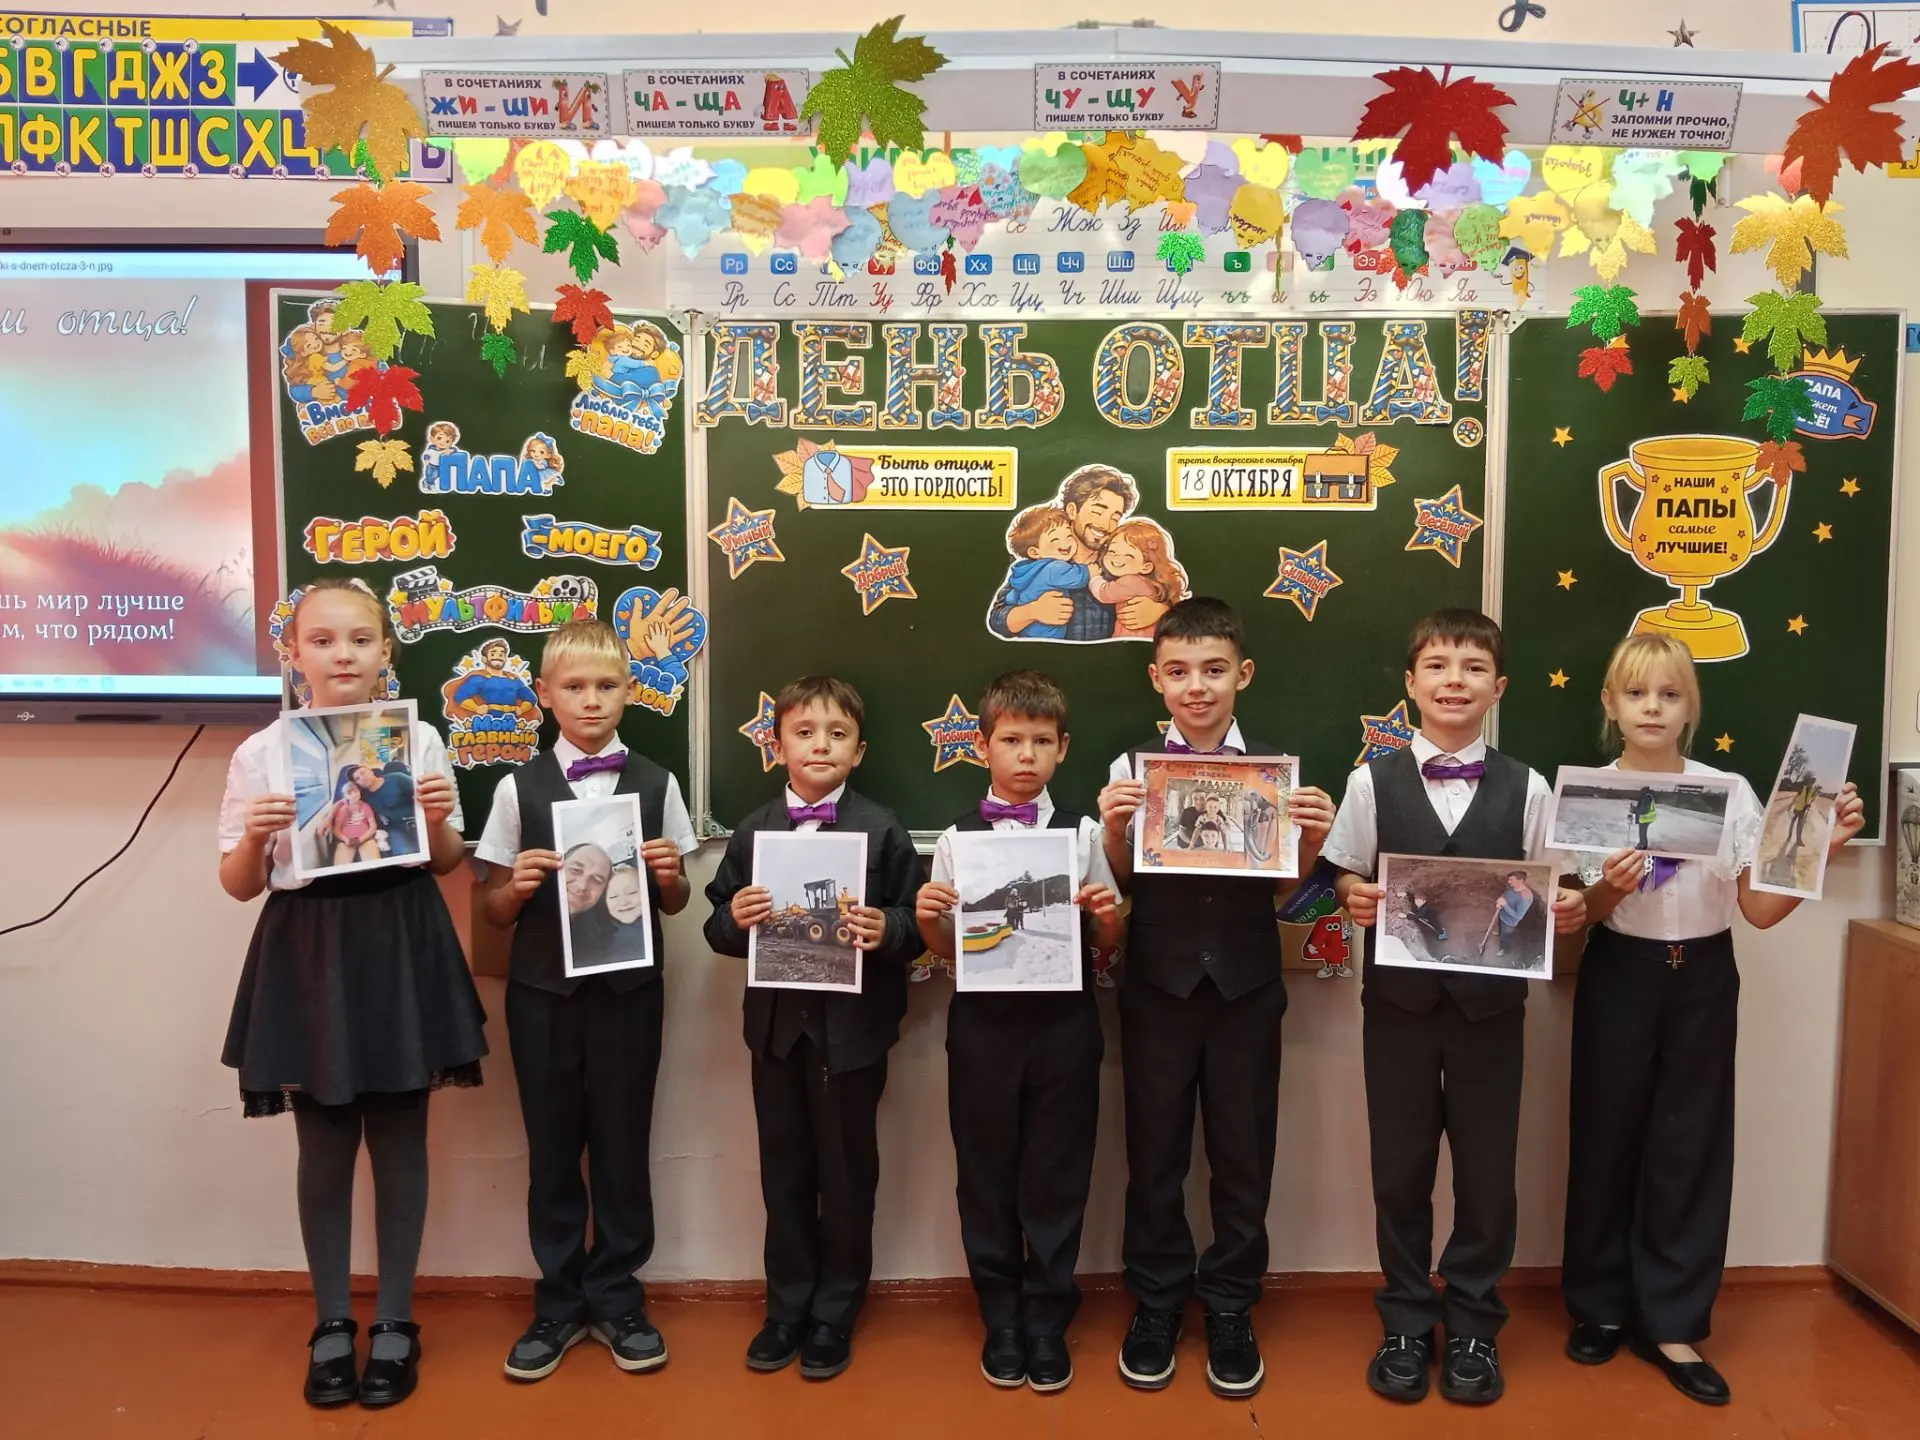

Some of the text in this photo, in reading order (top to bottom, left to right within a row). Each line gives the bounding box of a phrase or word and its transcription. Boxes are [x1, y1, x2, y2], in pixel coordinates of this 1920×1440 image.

[0, 16, 151, 37] ОГЛАСНЫЕ
[445, 78, 542, 89] В СОЧЕТАНИЯХ
[648, 75, 745, 85] В СОЧЕТАНИЯХ
[1058, 70, 1155, 81] В СОЧЕТАНИЯХ
[429, 95, 478, 117] ЖИ
[502, 95, 550, 117] ШИ
[634, 90, 670, 112] ЧА
[693, 90, 742, 116] ЩА
[1045, 87, 1082, 109] ЧУ
[1106, 86, 1156, 113] ЩУ
[438, 120, 556, 131] ПИШЕМ ТОЛЬКО БУКВУ
[636, 120, 755, 130] ПИШЕМ ТОЛЬКО БУКВУ
[1045, 112, 1164, 122] ПИШЕМ ТОЛЬКО БУКВУ
[1611, 114, 1731, 128] ЗАПОМНИ ПРОЧНО,
[1611, 128, 1726, 140] НЕ НУЖЕН ТОЧНО!
[57, 295, 199, 341] отца!
[695, 308, 1492, 447] ДЕНЬ ОТЦА!
[575, 394, 630, 421] Люблю
[877, 454, 930, 471] Быть
[934, 457, 995, 473] отцом
[1177, 455, 1304, 468] третье воскресенье октября
[438, 453, 544, 494] ПАПА
[1181, 468, 1293, 499] 18 ОКТЯБРЯ
[1674, 477, 1715, 488] НАШИ
[880, 475, 1004, 500] ЭТО ГОРДОСТЬ!
[1656, 498, 1737, 519] ПАПЫ
[720, 520, 773, 551] Умный
[1418, 510, 1471, 540] Весёлый
[1668, 524, 1717, 535] самые
[314, 510, 449, 562] ГЕРОЙ
[1655, 541, 1728, 554] ЛУЧШИЕ!
[855, 557, 907, 591] Добрый
[1280, 559, 1330, 596] Сильный
[37, 594, 89, 616] мир
[97, 593, 185, 617] лучше
[35, 623, 78, 640] что
[88, 618, 174, 645] рядом!
[472, 715, 517, 733] Мой
[452, 729, 537, 748] главный
[458, 744, 530, 765] герой
